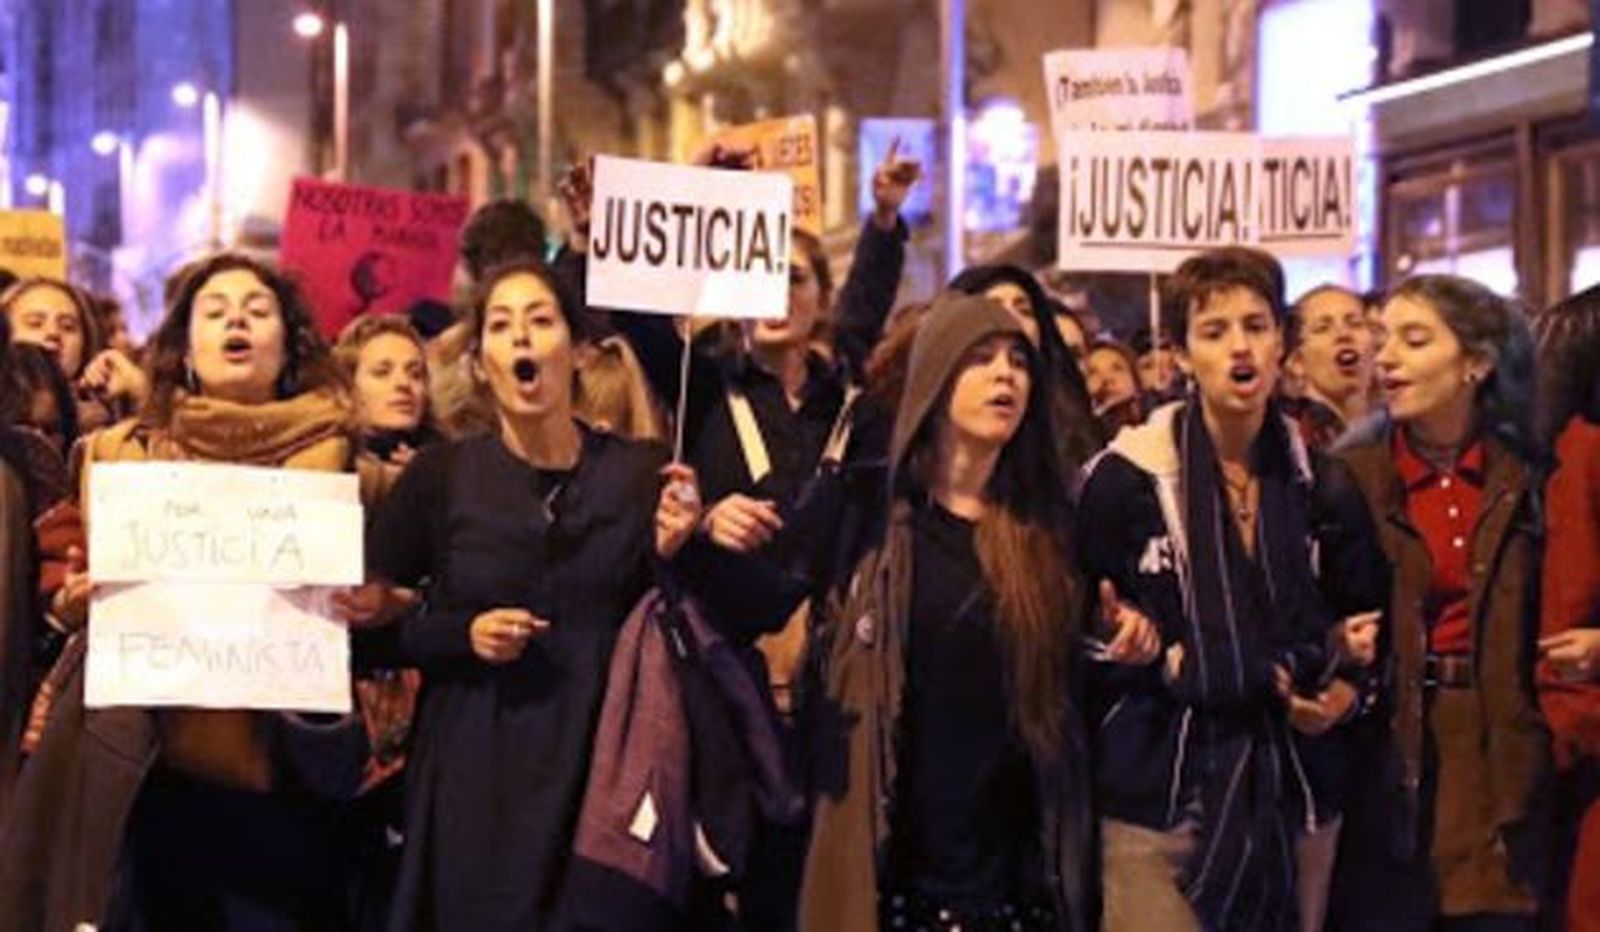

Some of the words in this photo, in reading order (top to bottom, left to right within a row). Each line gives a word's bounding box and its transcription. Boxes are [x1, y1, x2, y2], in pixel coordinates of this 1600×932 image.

[1069, 156, 1254, 241] ¡JUSTICIA!
[1259, 155, 1352, 231] TICIA!
[593, 197, 787, 274] JUSTICIA!
[120, 519, 305, 571] JUSTICIA
[118, 630, 325, 676] FEMINISTA
